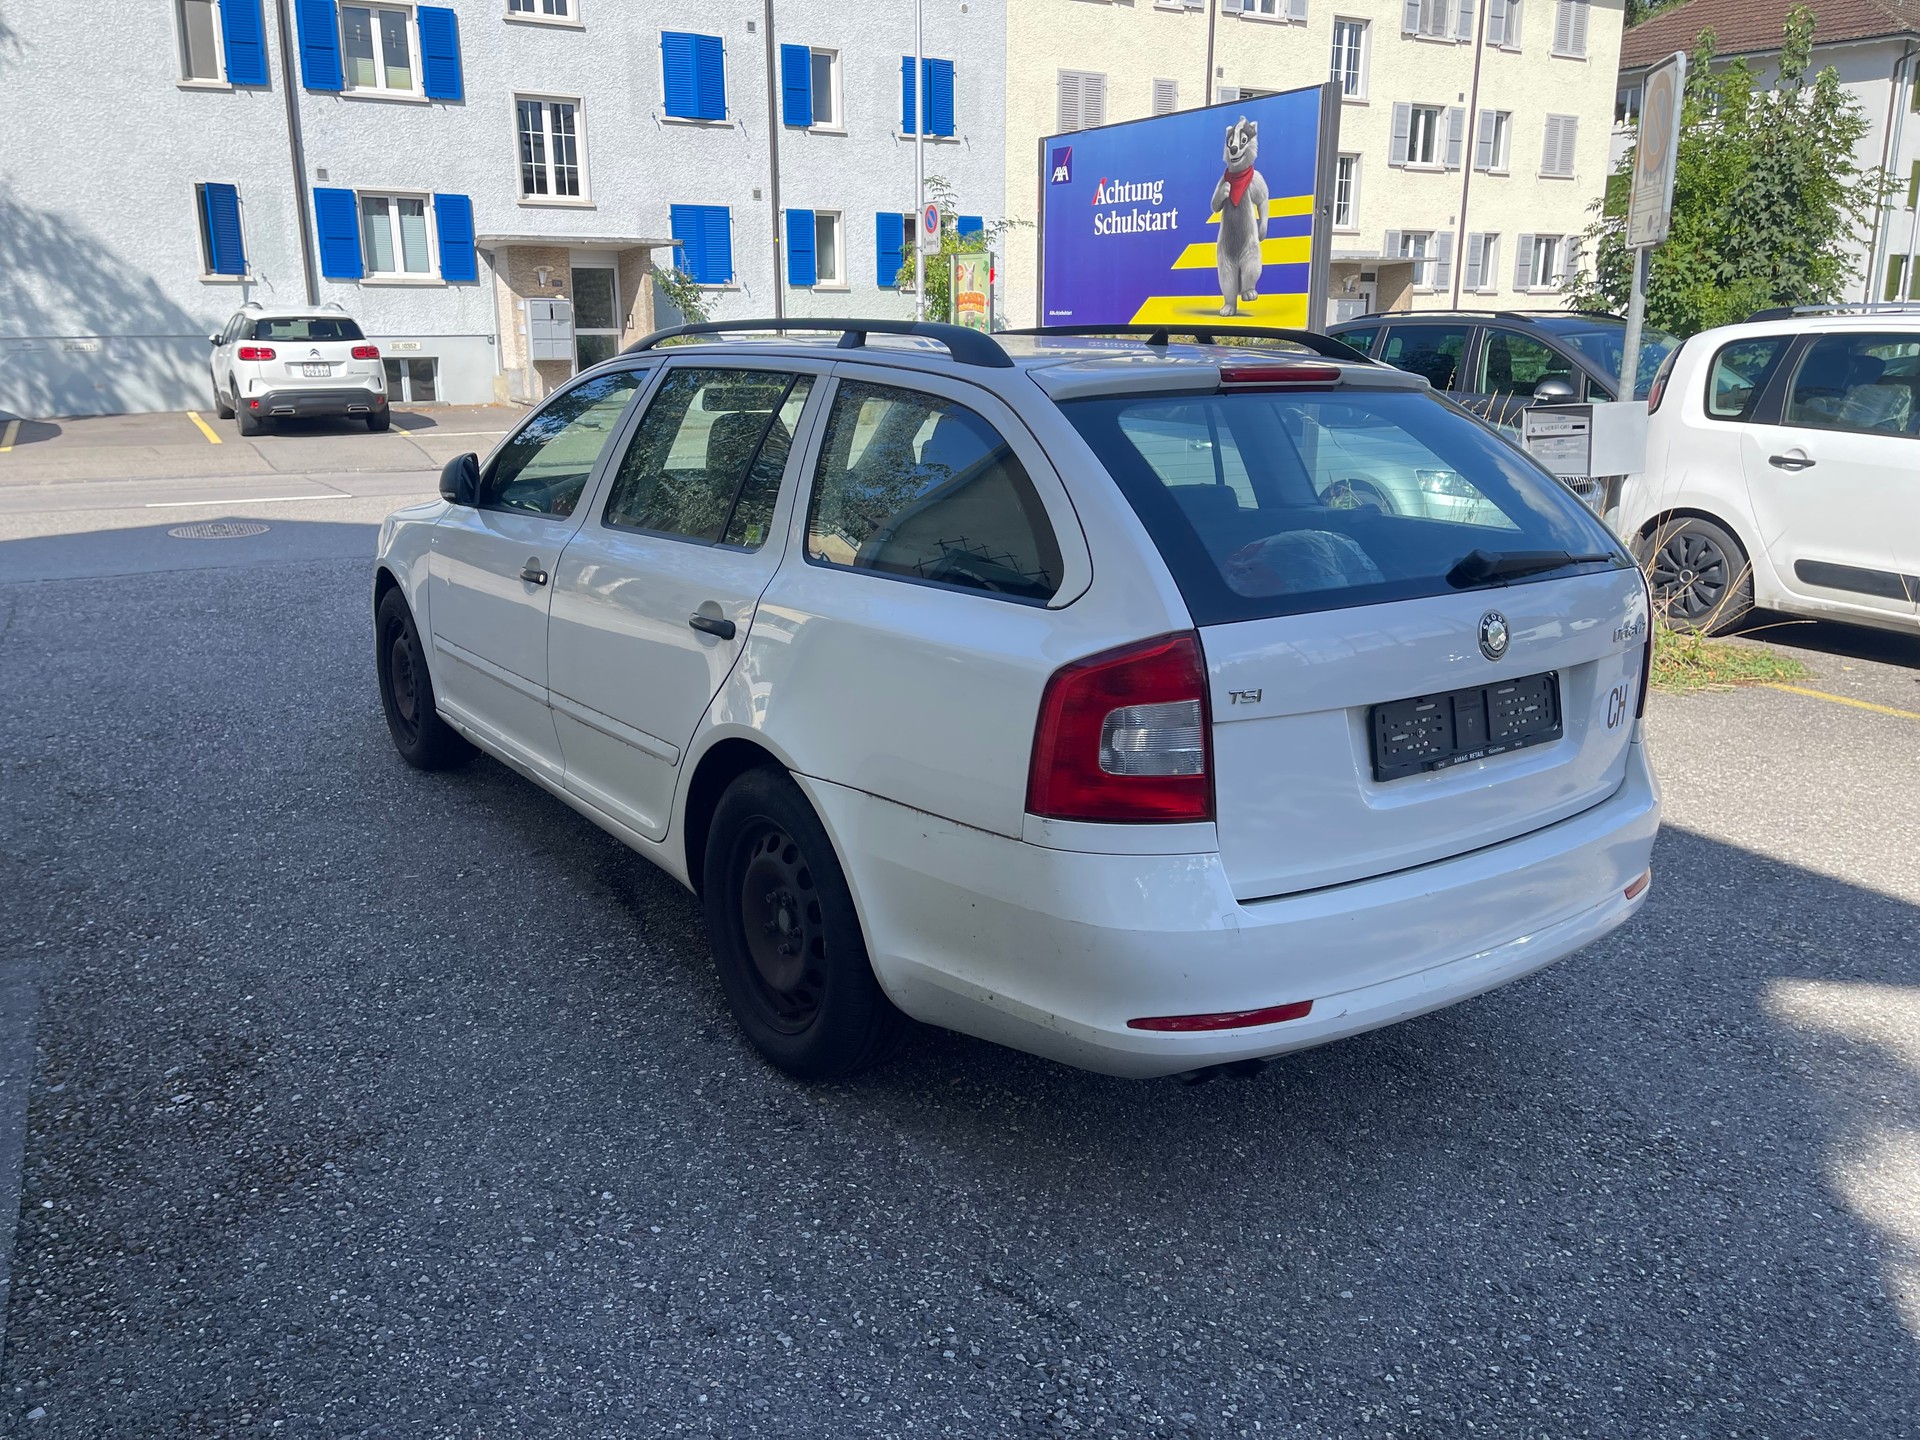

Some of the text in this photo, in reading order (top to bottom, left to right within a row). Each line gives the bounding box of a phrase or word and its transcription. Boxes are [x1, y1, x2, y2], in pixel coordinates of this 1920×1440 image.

[1051, 165, 1069, 183] AXA
[1094, 178, 1165, 206] Achtung
[1094, 208, 1178, 236] Schulstart
[1228, 688, 1263, 705] TSI
[1607, 683, 1629, 730] CH
[1453, 754, 1468, 764] AMAG
[1469, 750, 1485, 760] RETAIL
